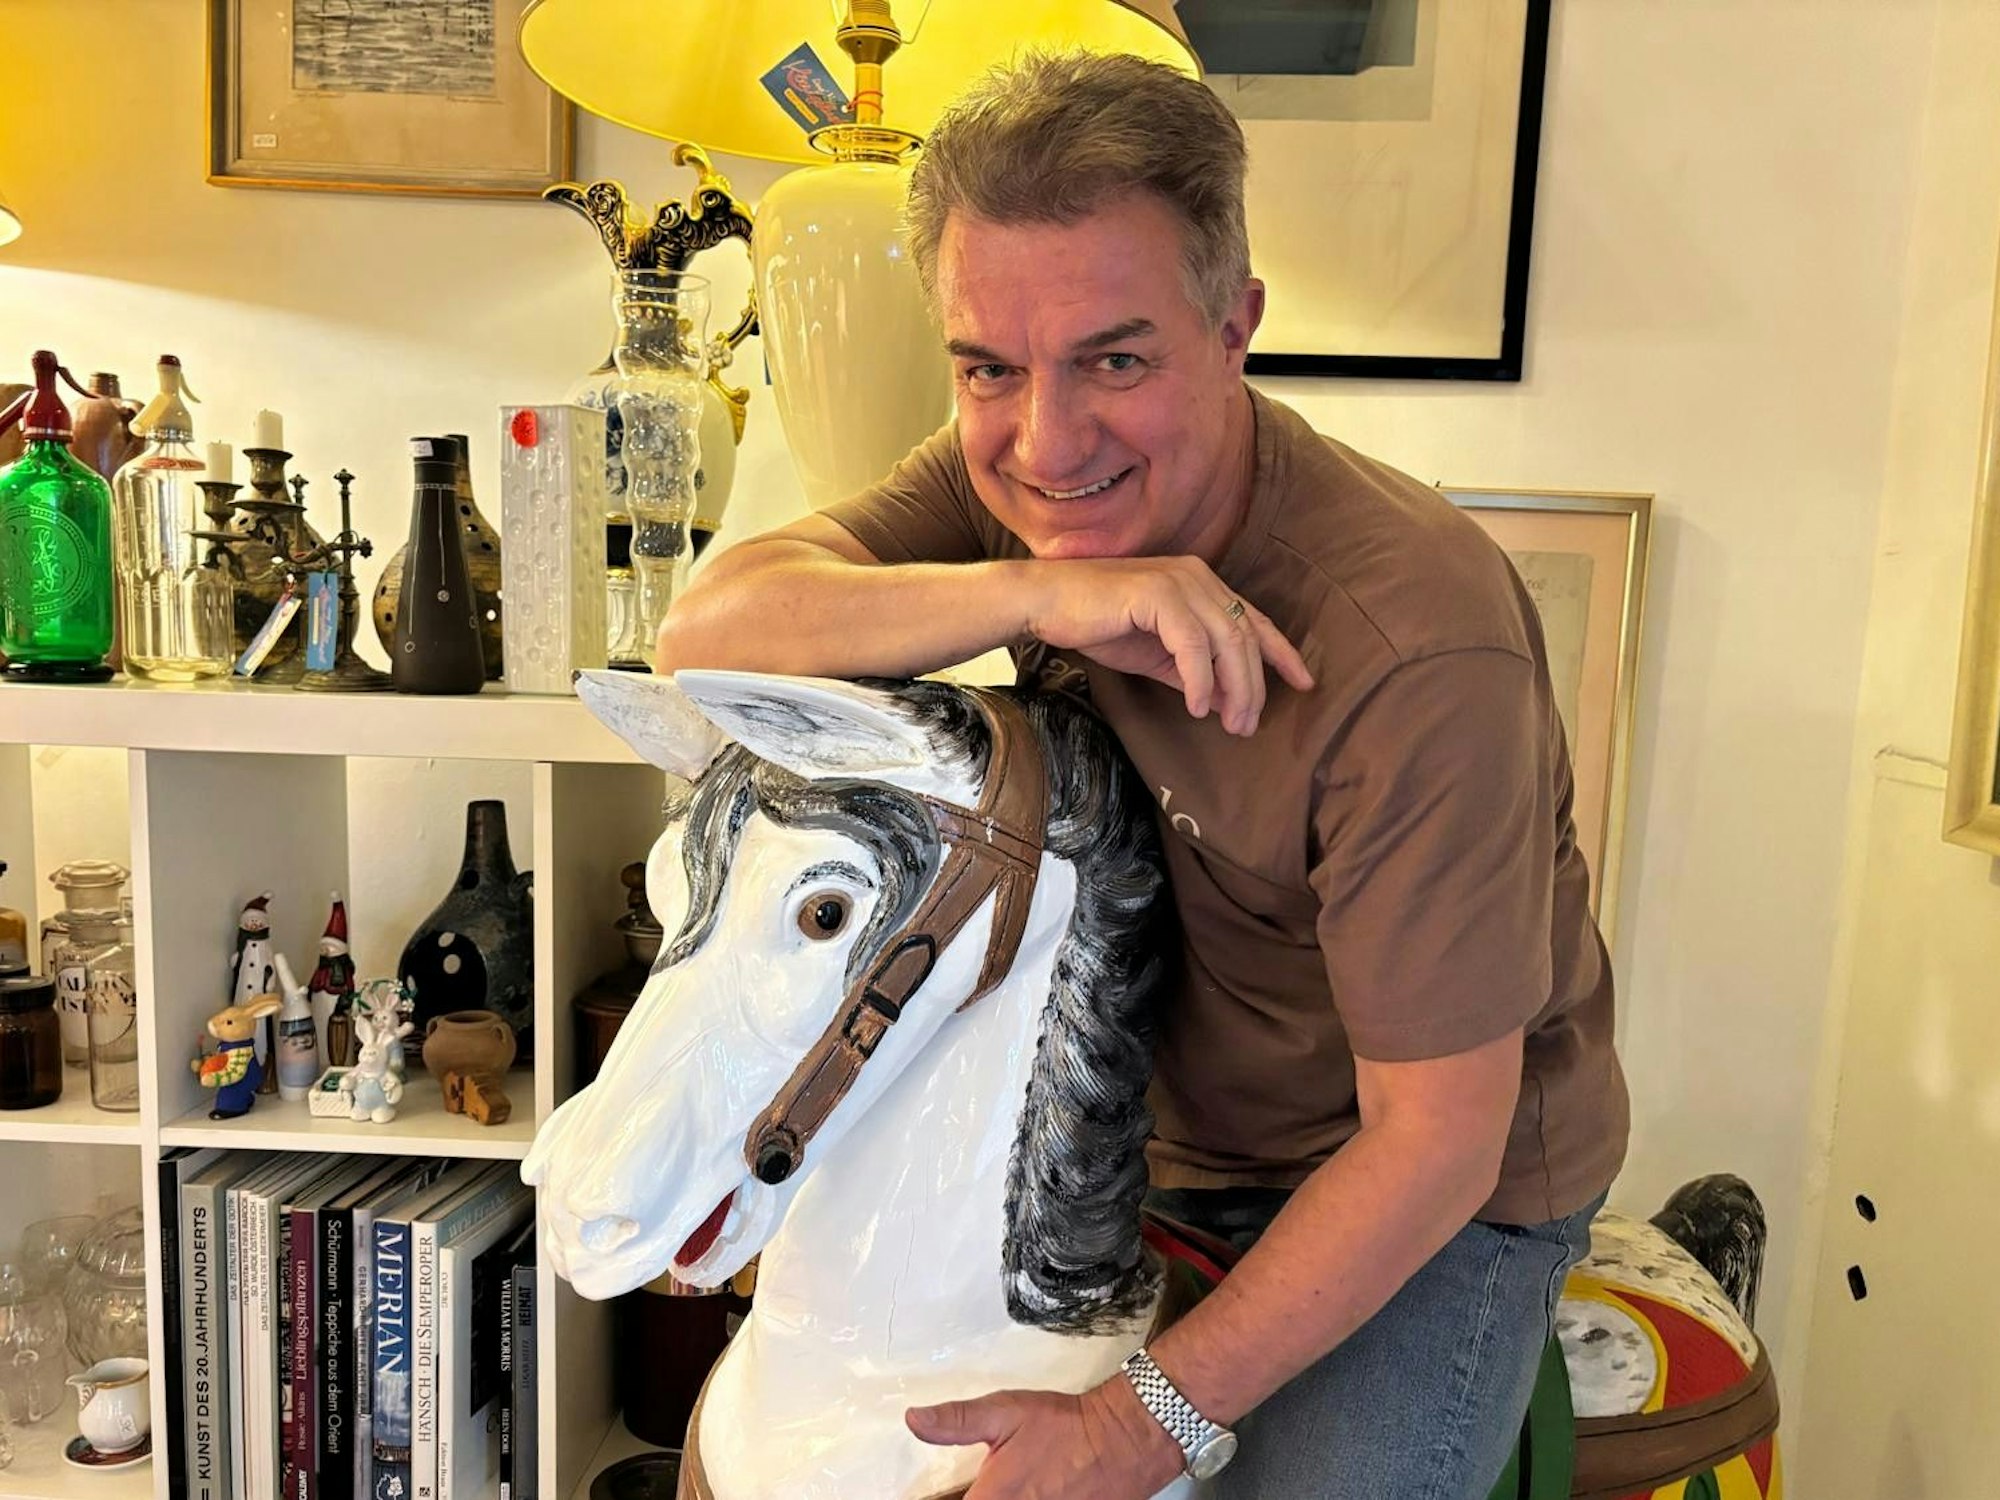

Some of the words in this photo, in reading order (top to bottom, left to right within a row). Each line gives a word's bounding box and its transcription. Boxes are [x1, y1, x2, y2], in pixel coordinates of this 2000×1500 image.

[229, 1242, 237, 1281] ZEITALTER
[250, 1255, 258, 1283] WURDE
[328, 1220, 341, 1289] Schürmann
[229, 1285, 237, 1300] DAS
[250, 1285, 258, 1297] SO
[377, 1230, 404, 1376] MERIAN
[417, 1236, 432, 1339] SEMPEROPER
[501, 1279, 511, 1327] WILLIAM
[519, 1286, 531, 1326] HEIMAT
[295, 1260, 309, 1380] Lieblingspflanzen
[326, 1299, 341, 1356] Teppiche
[328, 1359, 338, 1380] aus
[418, 1342, 431, 1367] DIE
[501, 1331, 511, 1371] MORRIS
[197, 1381, 209, 1417] DES
[328, 1383, 341, 1411] dem
[418, 1378, 431, 1442] HÄNSCH
[198, 1421, 210, 1479] KUNST
[328, 1414, 341, 1454] Orient
